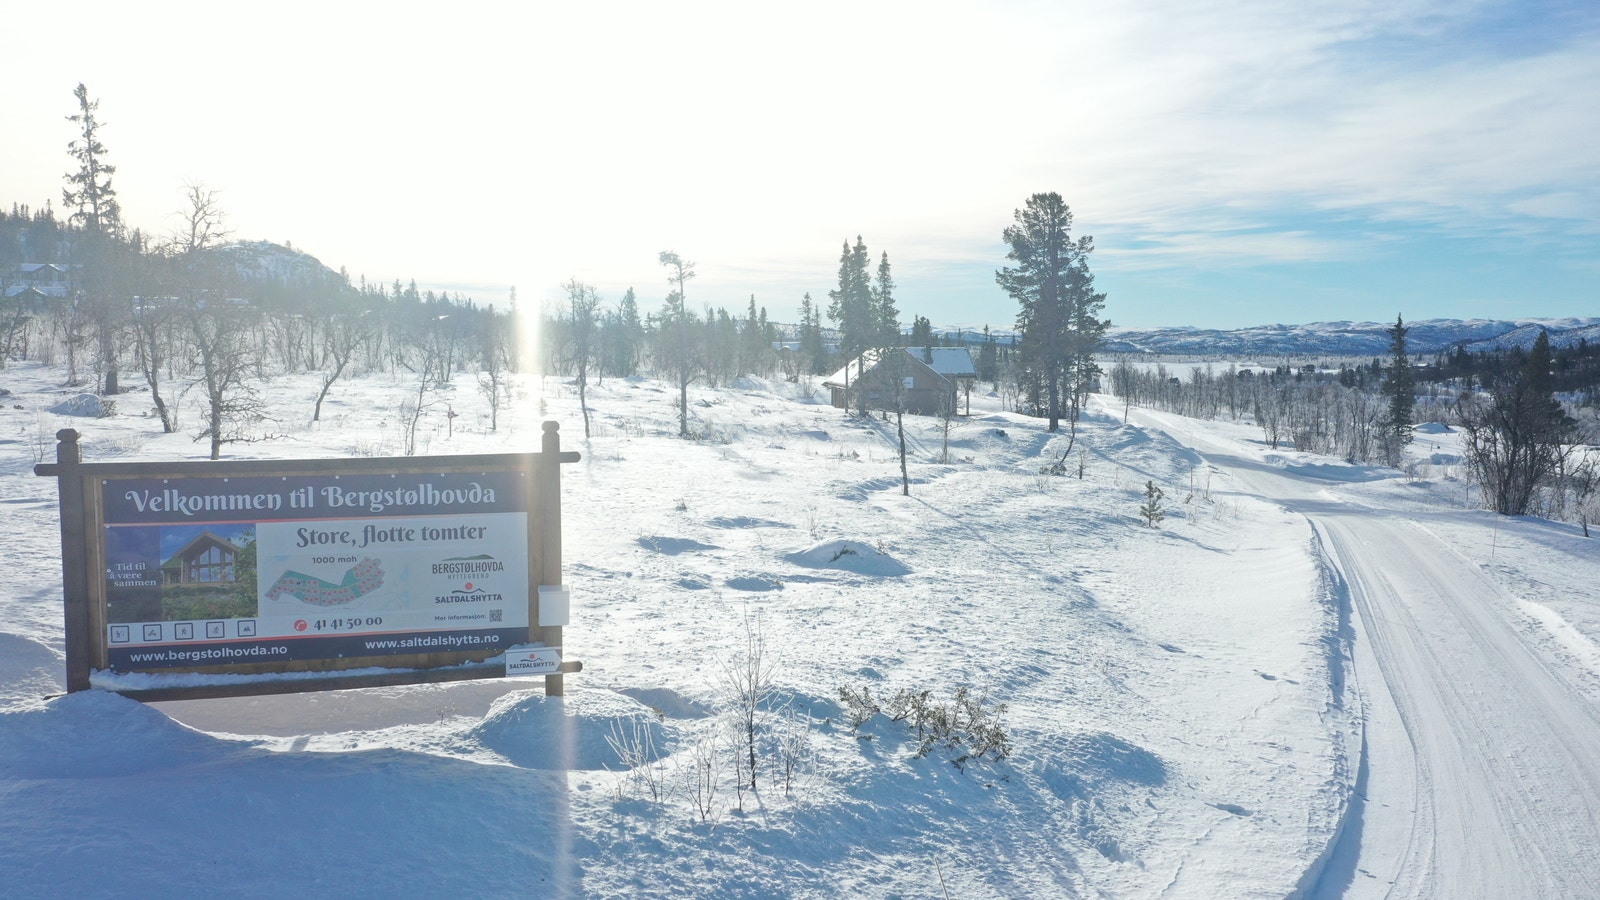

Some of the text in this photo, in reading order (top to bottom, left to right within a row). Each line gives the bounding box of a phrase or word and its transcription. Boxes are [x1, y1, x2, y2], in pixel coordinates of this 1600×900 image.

[125, 482, 496, 516] Velkommen til Bergstølhovda
[296, 524, 487, 548] Store, flotte tomter
[115, 562, 146, 570] Tid til
[312, 556, 335, 564] 1000
[432, 561, 504, 574] BERGSTØLHOVDA
[435, 594, 503, 604] SALTDALSHYTTA
[314, 619, 326, 630] 41
[330, 618, 343, 630] 41
[346, 618, 362, 630] 50
[365, 635, 500, 649] www.saltdalshytta.no
[130, 645, 288, 662] www.bergstolhovda.no
[509, 661, 556, 670] SALTDALSHYTTA
